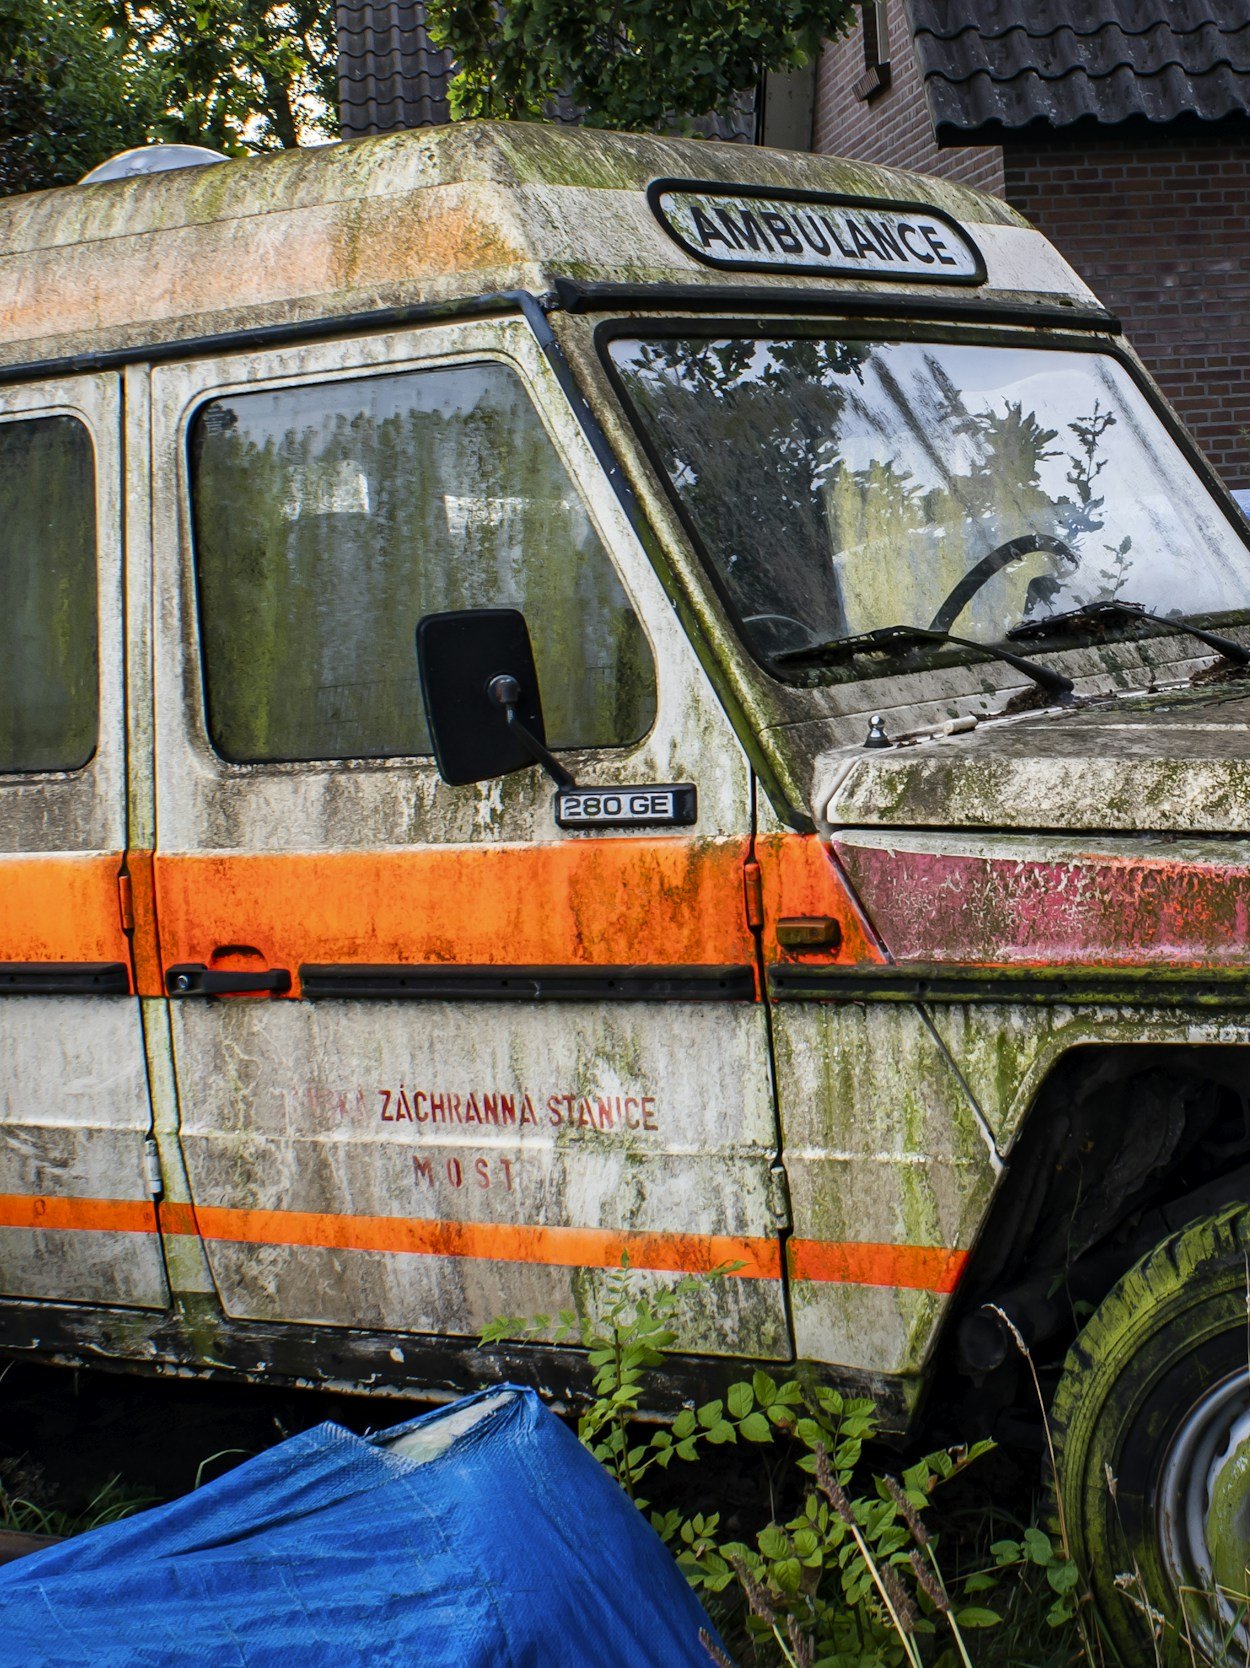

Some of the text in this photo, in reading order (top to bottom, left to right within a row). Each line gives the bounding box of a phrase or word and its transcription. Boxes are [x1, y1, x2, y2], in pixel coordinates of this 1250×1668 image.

[690, 206, 957, 266] AMBULANCE
[564, 795, 669, 816] 280 GE
[547, 1094, 659, 1131] STANICE
